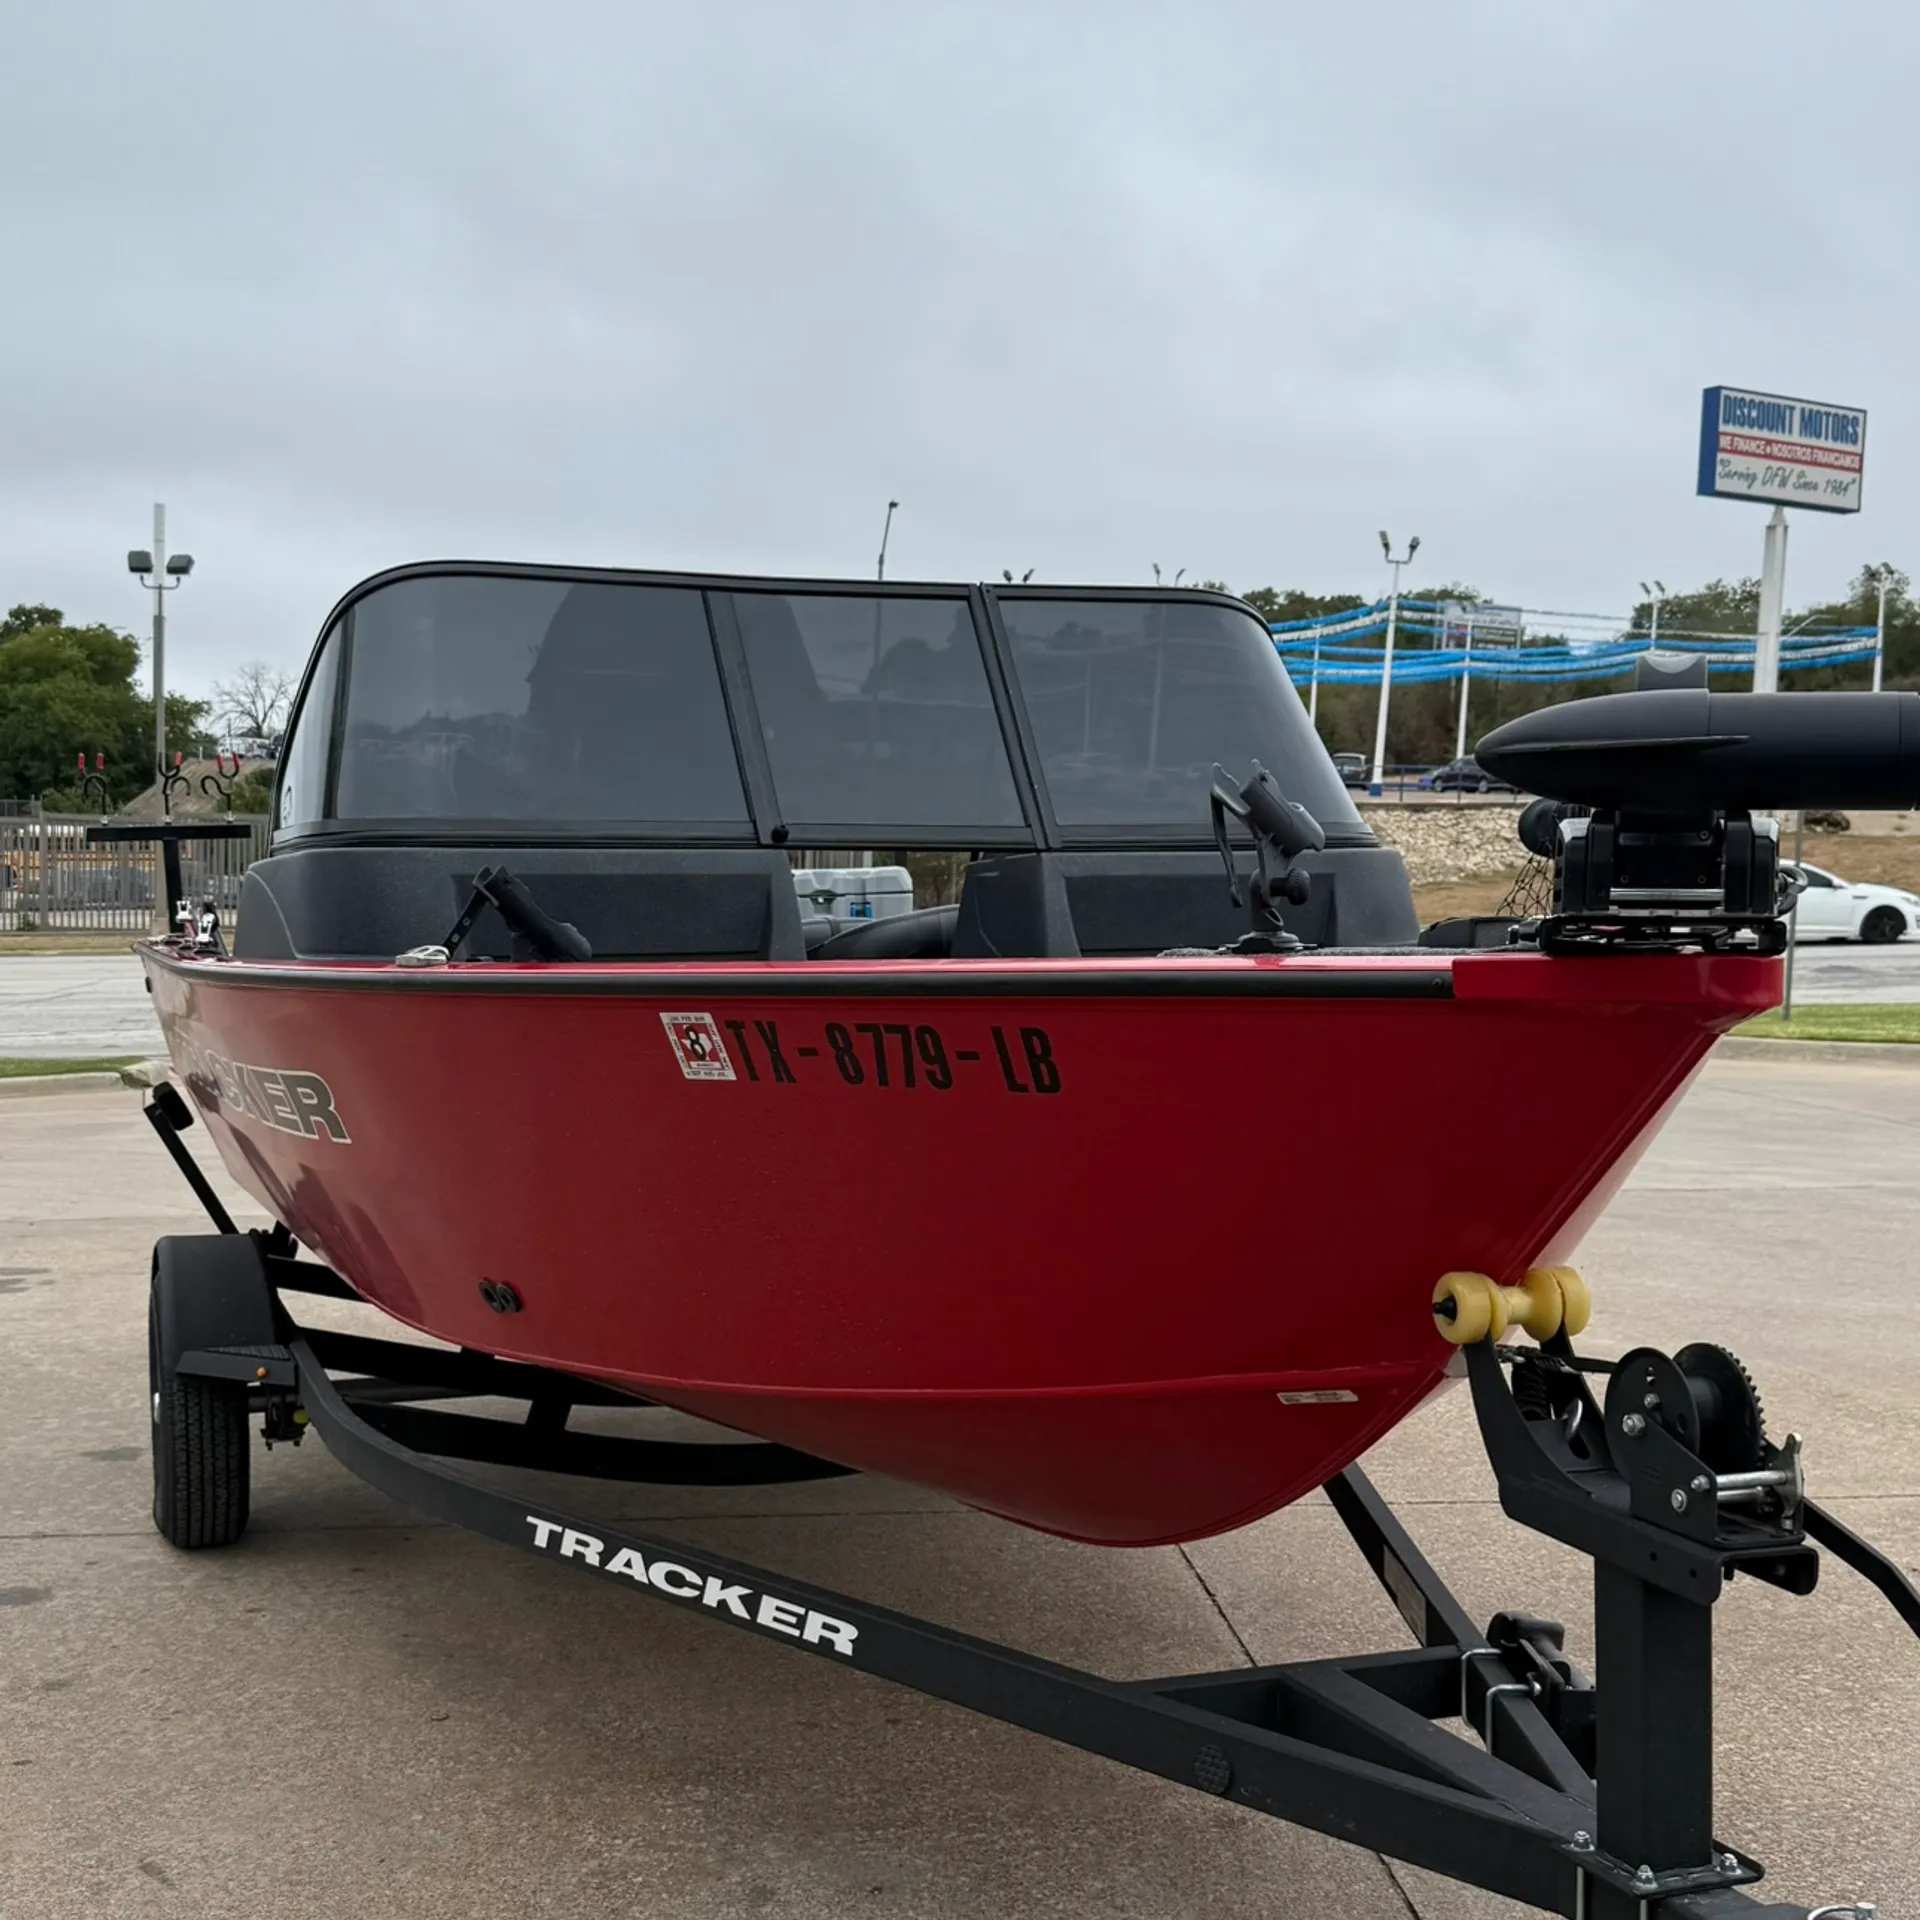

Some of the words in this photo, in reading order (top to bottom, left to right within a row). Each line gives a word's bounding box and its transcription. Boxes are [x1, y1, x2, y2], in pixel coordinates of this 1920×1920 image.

[1722, 394, 1796, 436] DISCOUNT
[1799, 407, 1860, 446] MOTORS
[1733, 436, 1766, 455] FINANCE
[1761, 466, 1793, 489] DFW
[1793, 470, 1818, 491] Since
[685, 1026, 707, 1061] 8
[525, 1515, 859, 1656] TRACKER
